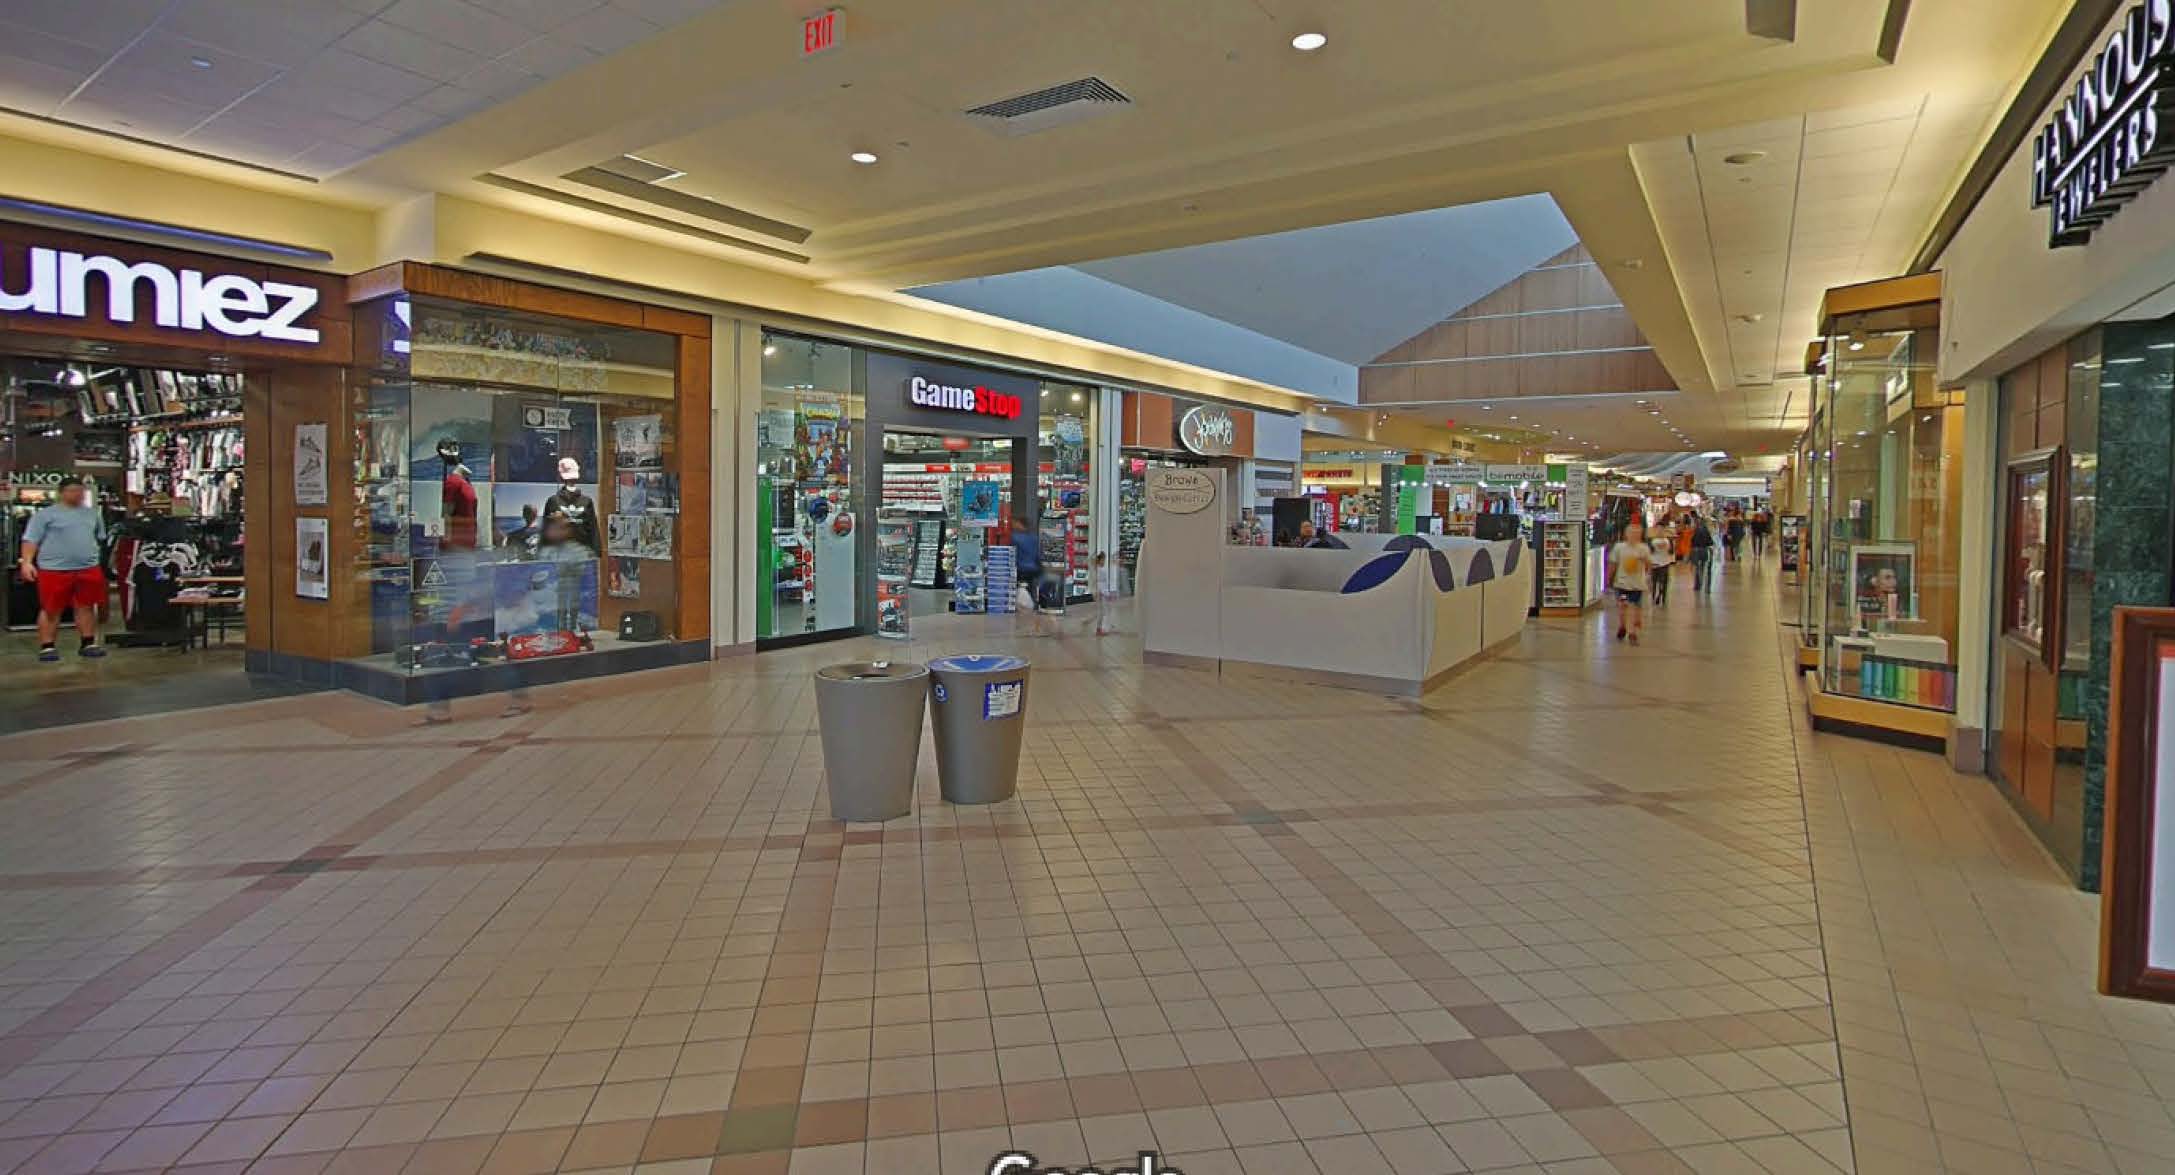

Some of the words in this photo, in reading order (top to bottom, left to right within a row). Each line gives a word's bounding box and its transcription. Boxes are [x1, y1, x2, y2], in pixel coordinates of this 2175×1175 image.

[804, 13, 834, 54] EXIT
[2031, 0, 2175, 209] HANNOUS
[911, 376, 1022, 420] GameStop
[8, 471, 79, 485] NIXO
